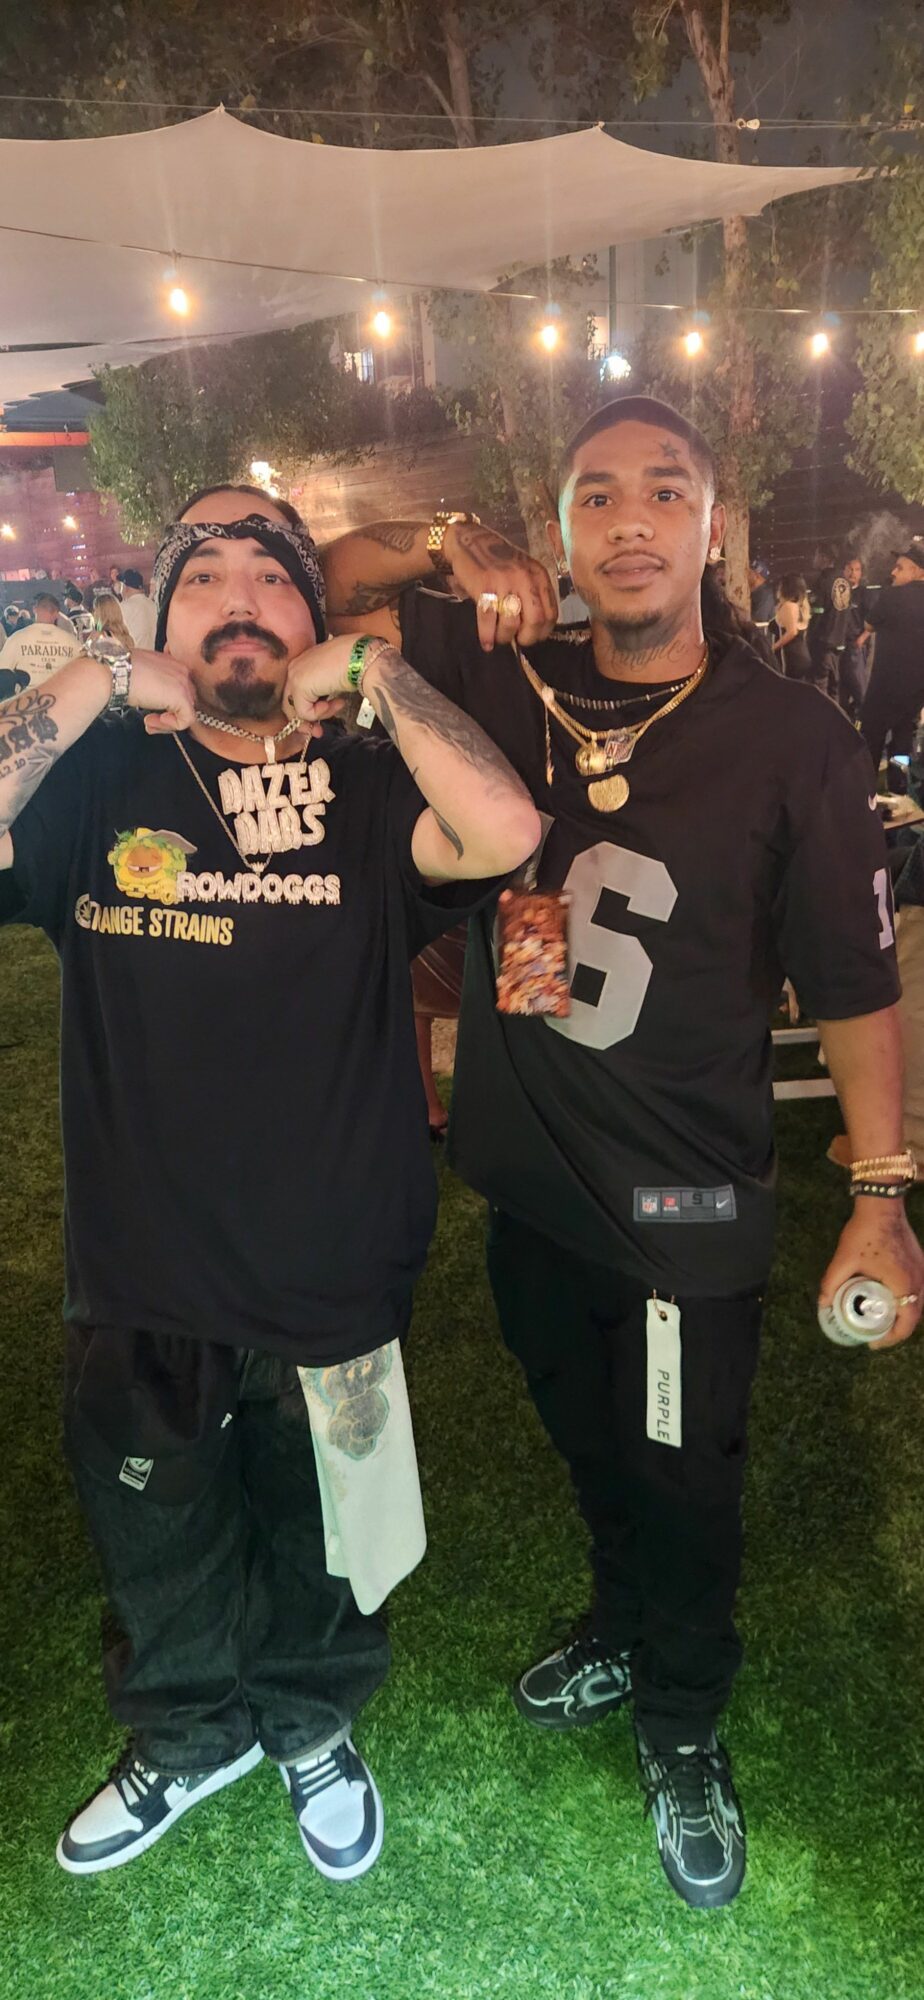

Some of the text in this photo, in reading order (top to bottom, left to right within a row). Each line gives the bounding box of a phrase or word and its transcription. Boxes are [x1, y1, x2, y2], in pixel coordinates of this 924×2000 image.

[21, 645, 74, 658] PARADISE
[217, 757, 336, 815] DAZER
[149, 908, 234, 946] STRAINS
[657, 1369, 671, 1441] PURPLE
